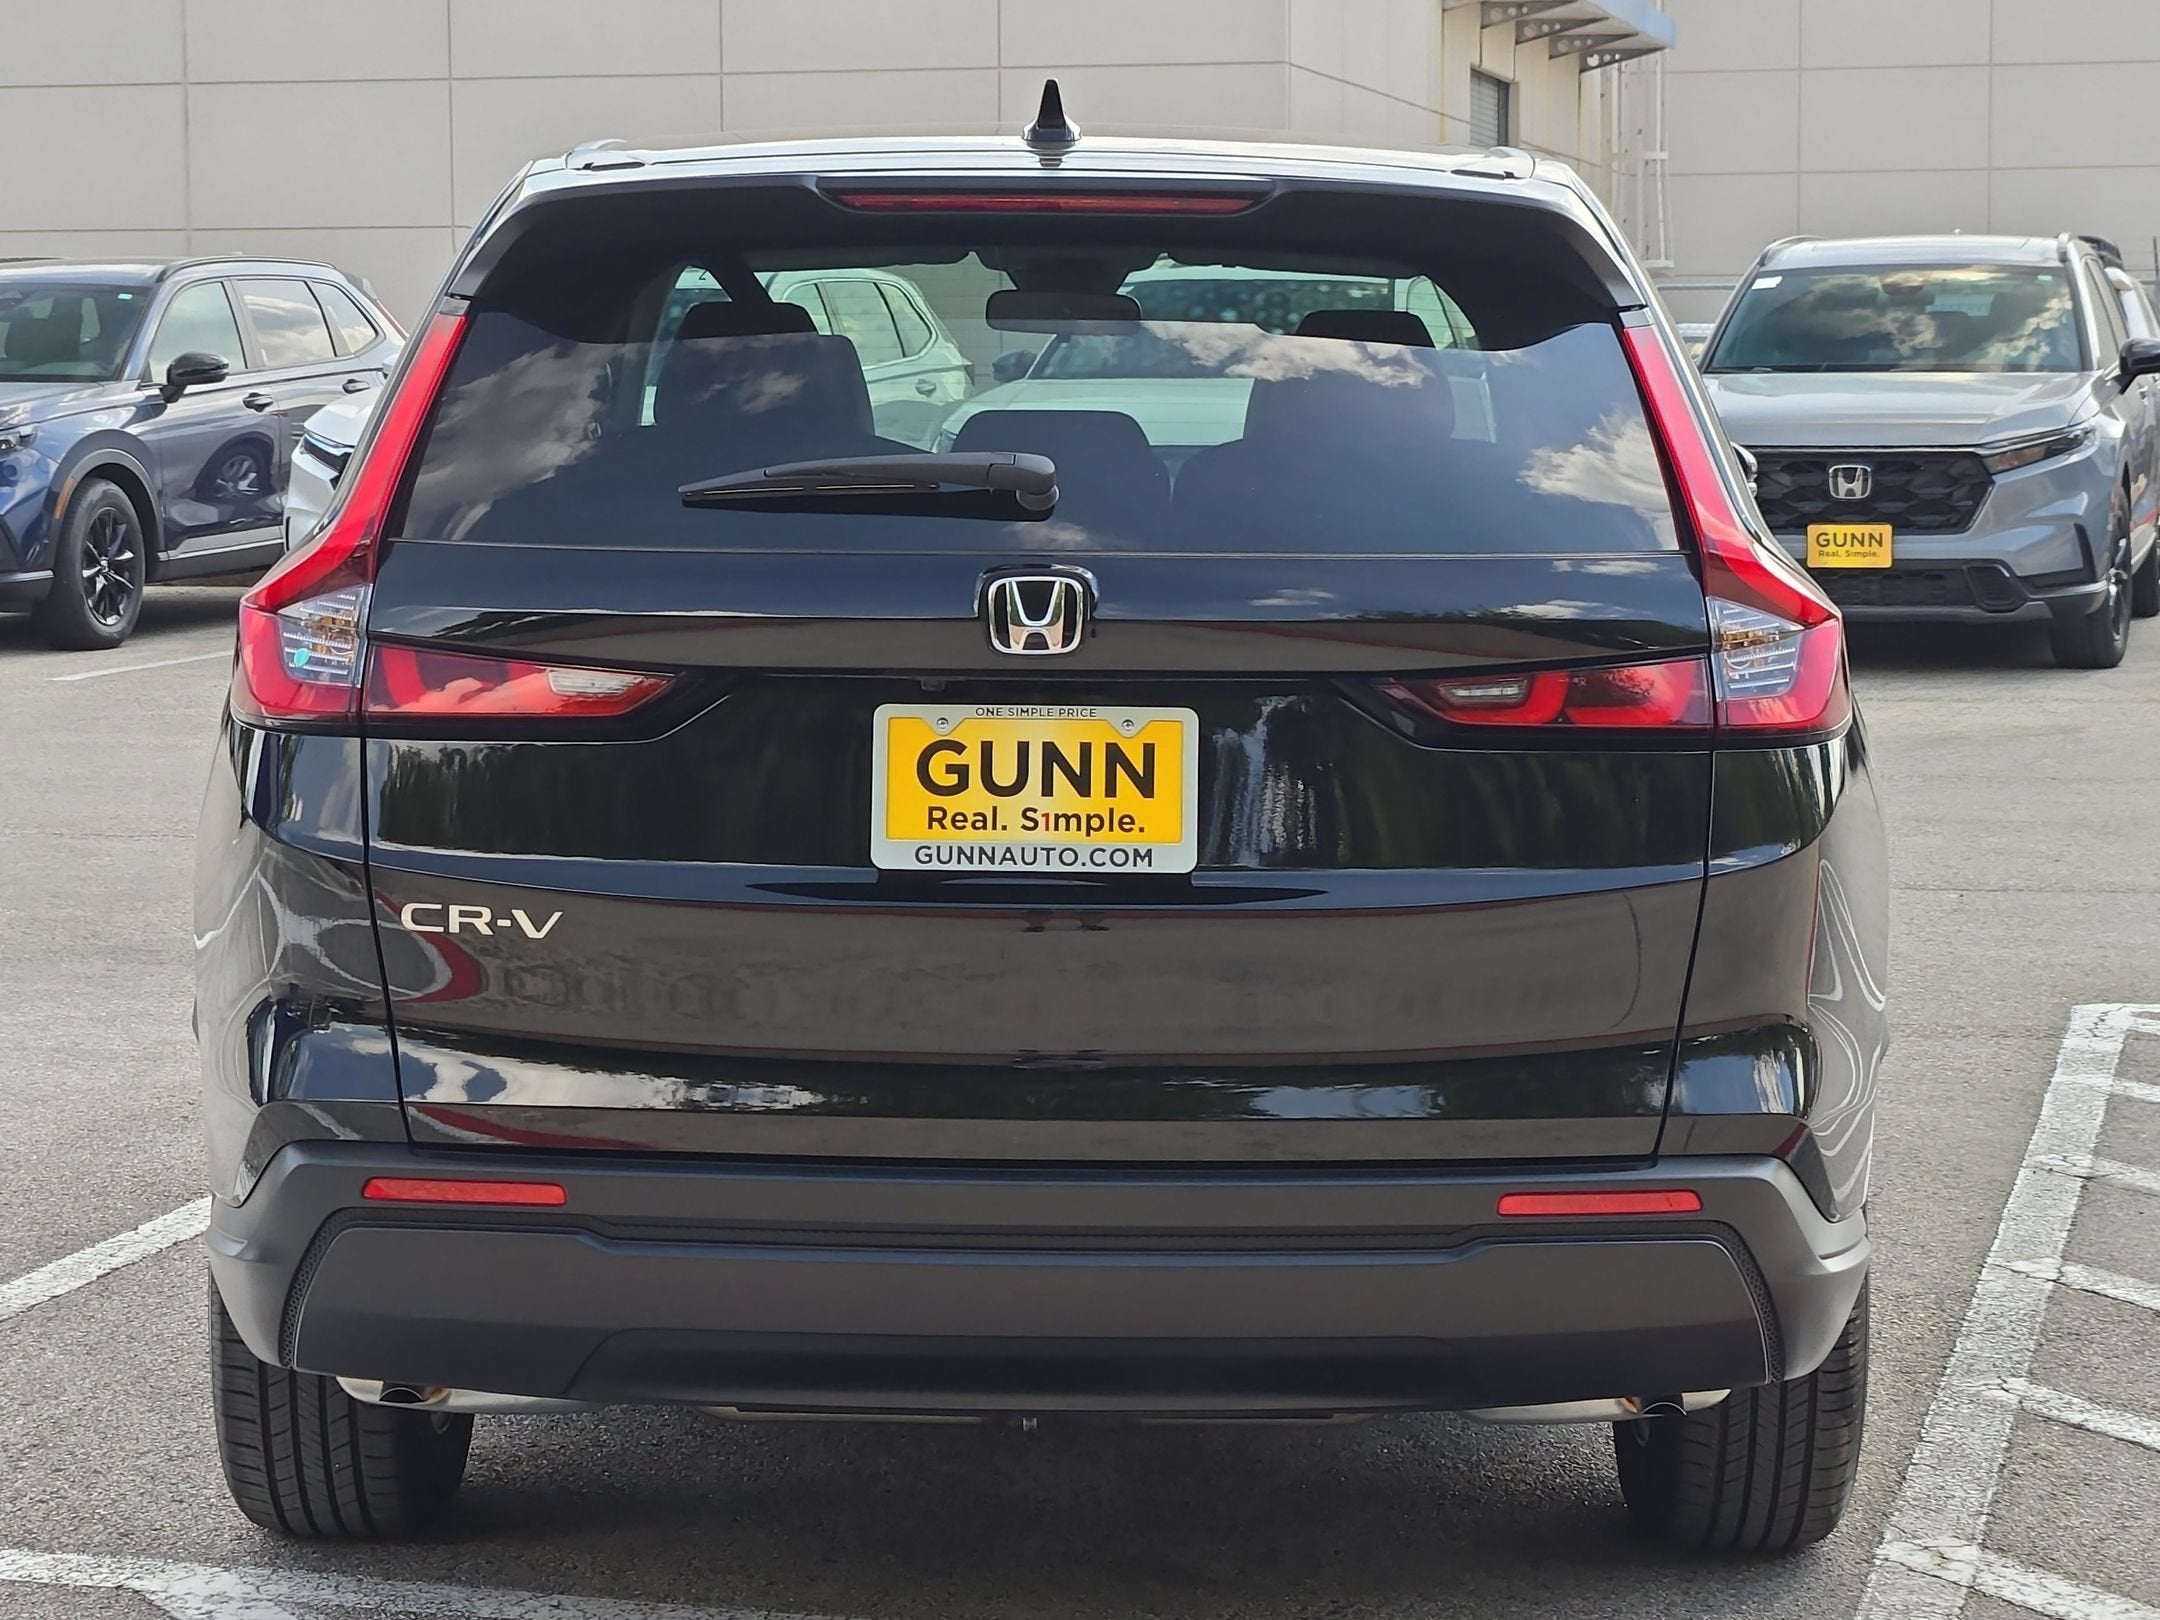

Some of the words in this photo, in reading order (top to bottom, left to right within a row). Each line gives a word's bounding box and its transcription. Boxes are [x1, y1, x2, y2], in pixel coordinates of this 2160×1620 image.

[1815, 532, 1883, 548] GUNN
[1818, 550, 1842, 558] Real.
[975, 706, 1002, 717] ONE
[1007, 707, 1054, 718] SIMPLE
[1058, 708, 1097, 718] PRICE
[915, 739, 1156, 799] GUNN
[927, 805, 1008, 831] Real.
[914, 844, 1153, 868] GUNNAUTO.COM
[400, 902, 564, 939] CR-V
